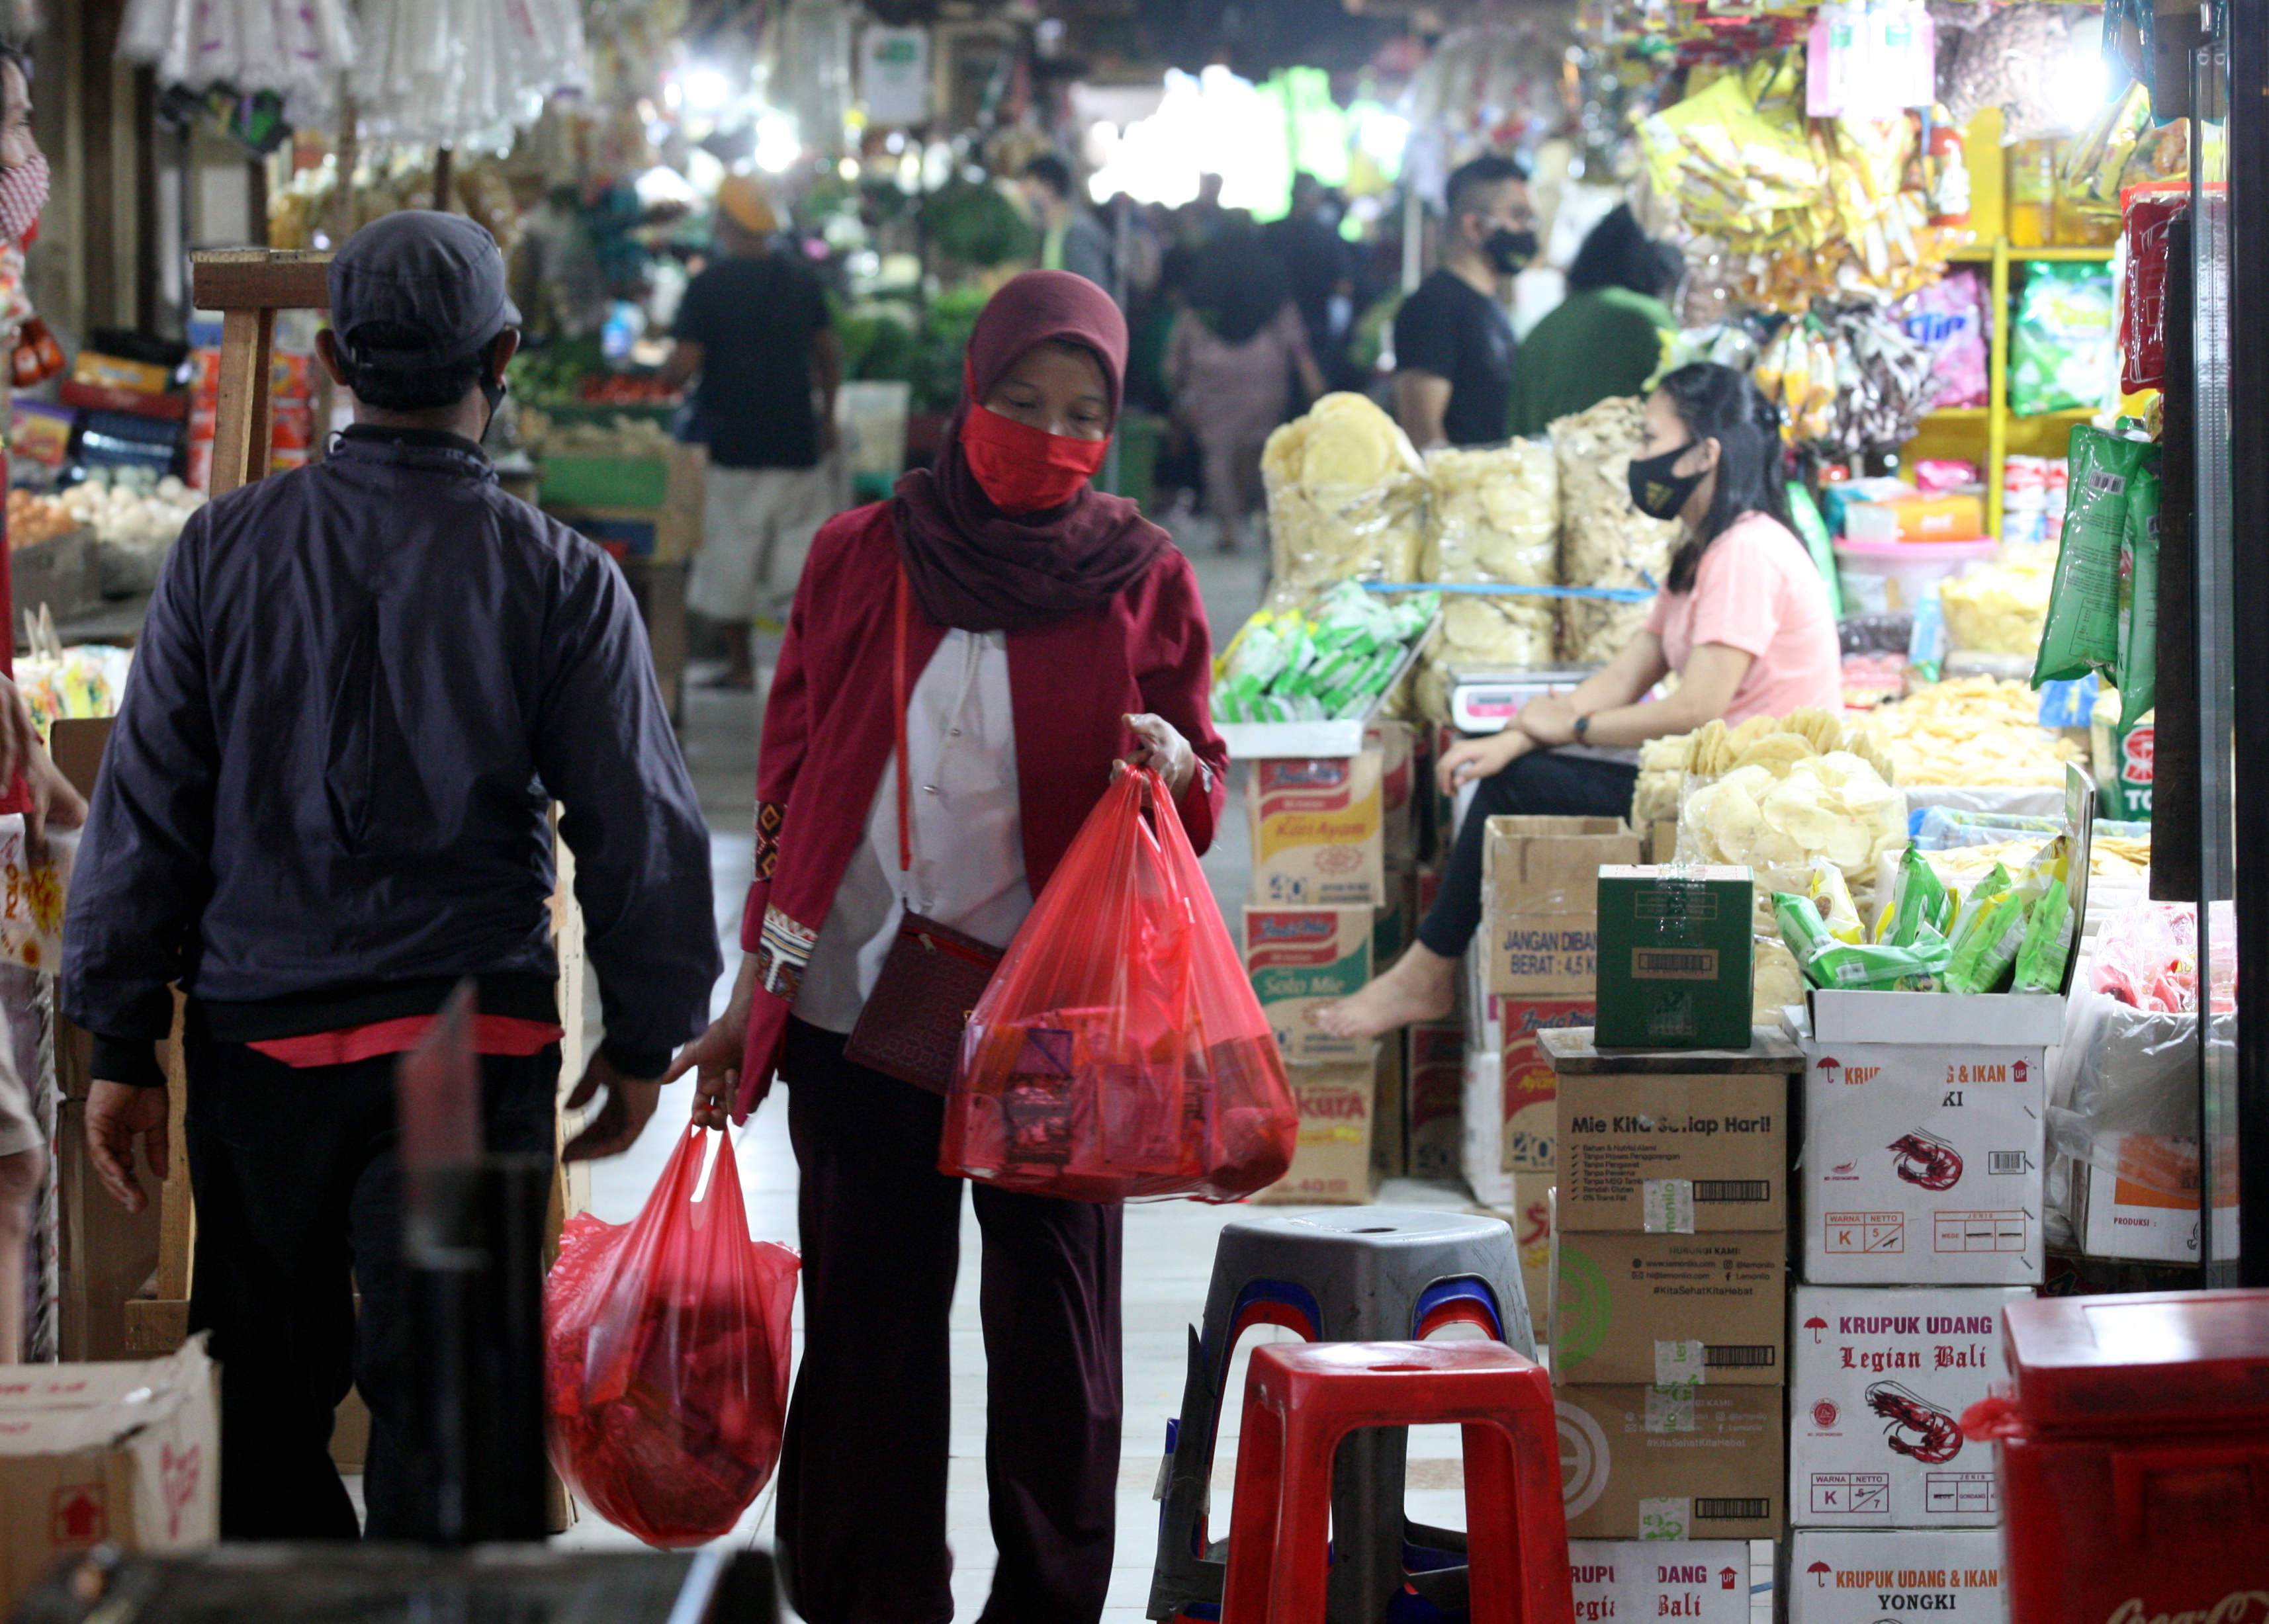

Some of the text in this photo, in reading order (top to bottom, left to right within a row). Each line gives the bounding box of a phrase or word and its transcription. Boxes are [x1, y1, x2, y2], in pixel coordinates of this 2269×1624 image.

[1504, 931, 1558, 951] JANGAN
[1511, 955, 1554, 974] BERAT
[1973, 1064, 2006, 1083] IKAN
[2015, 1070, 2025, 1079] UP
[1572, 1117, 1607, 1133] Mie
[1613, 1117, 1652, 1133] Kita
[1724, 1116, 1771, 1133] Hari!
[1830, 1215, 1861, 1223] WARNA
[2114, 1217, 2149, 1226] PRODUKSI
[1839, 1228, 1879, 1245] K 5
[1840, 1316, 1992, 1334] KRUPUK UDANG
[1840, 1344, 1986, 1373] Legian Bali
[1824, 1491, 1837, 1505] K
[1874, 1499, 1880, 1508] 7
[1722, 1573, 1734, 1582] UP
[1836, 1569, 1998, 1588] KRUPUK UDANG & IKAN
[1878, 1594, 1956, 1610] YONGKI
